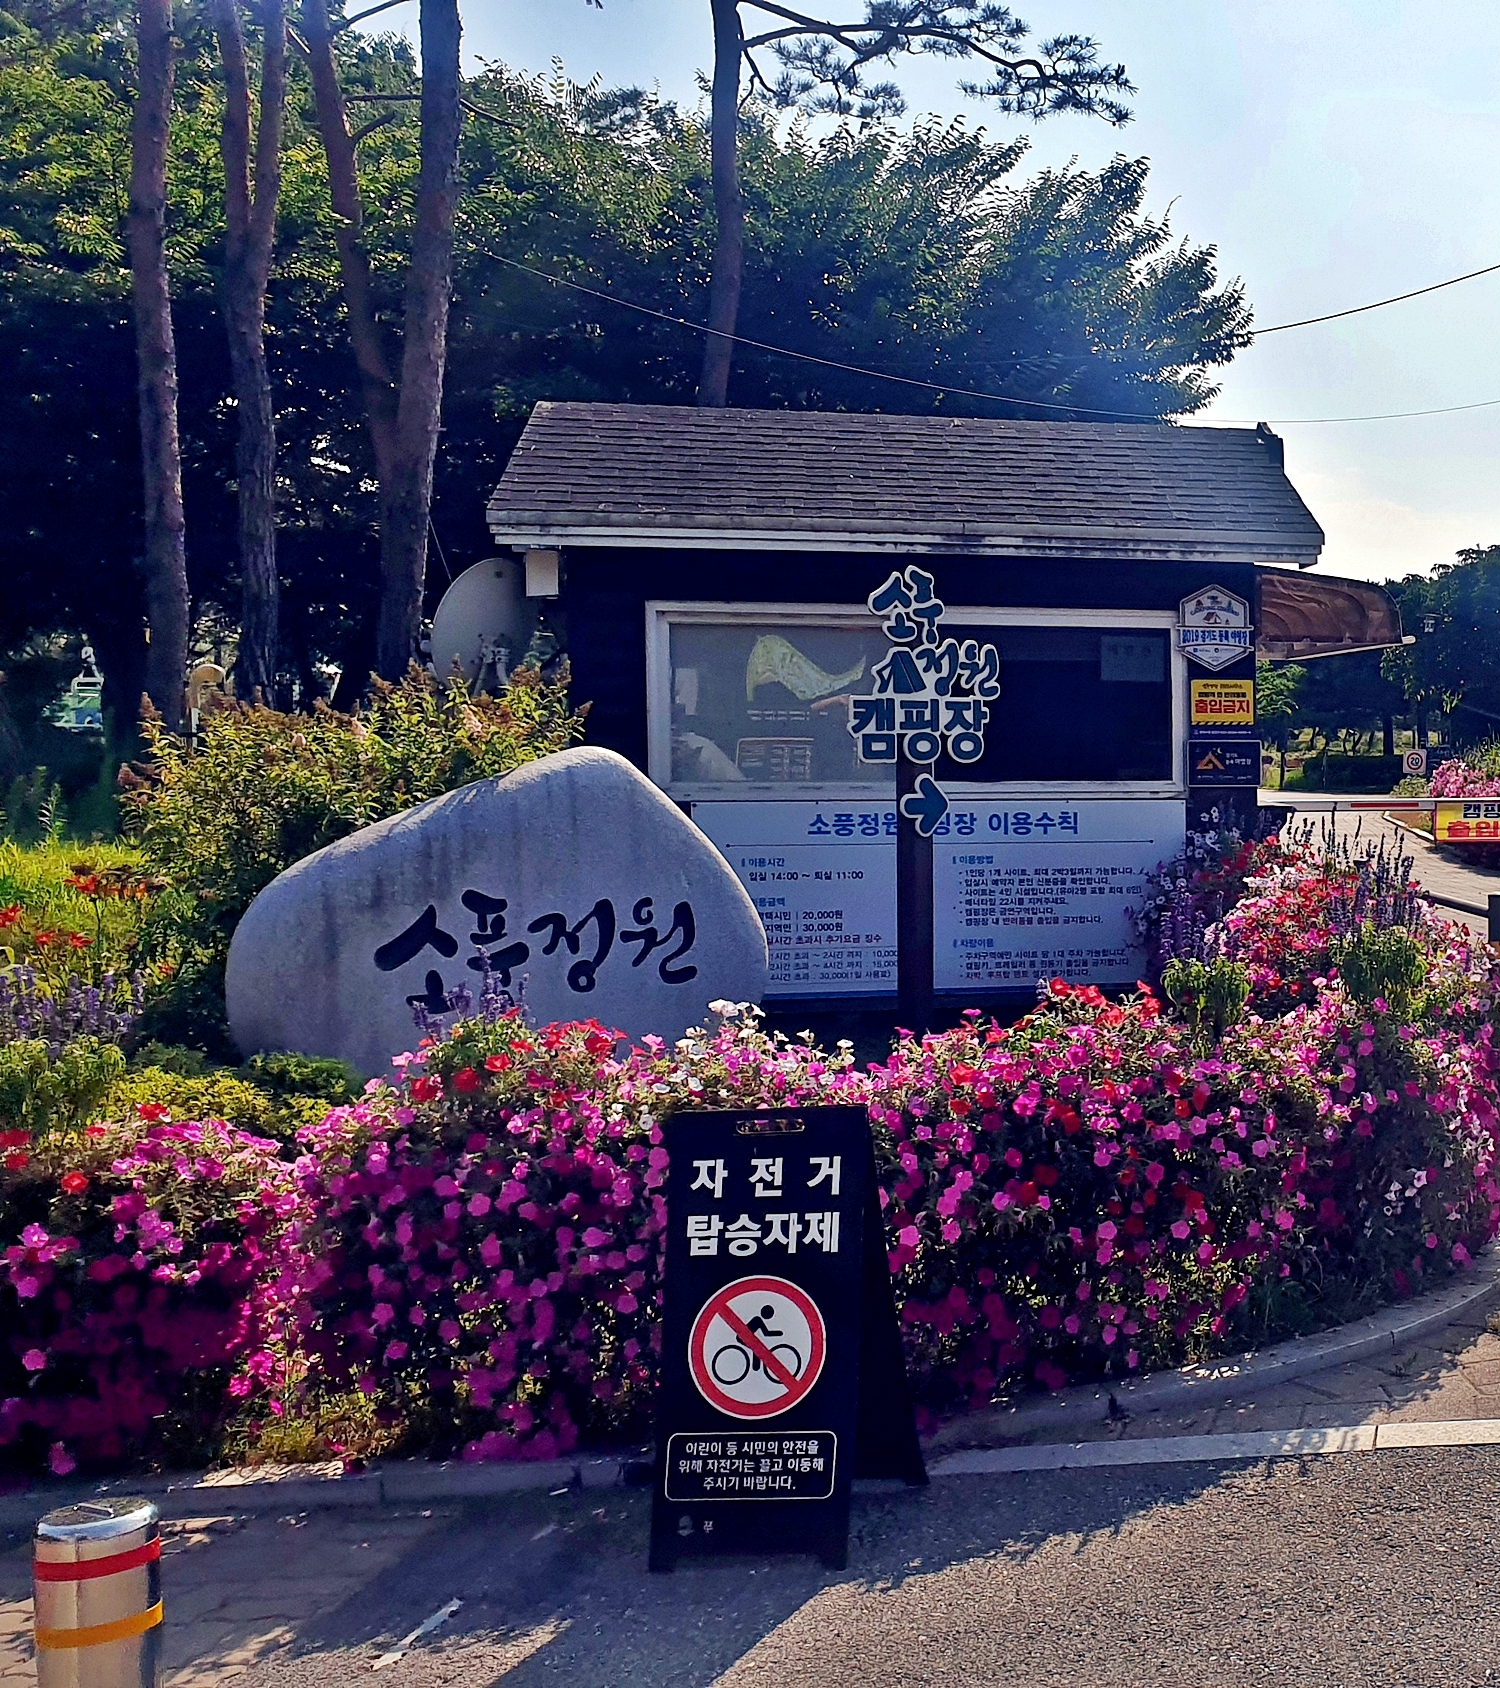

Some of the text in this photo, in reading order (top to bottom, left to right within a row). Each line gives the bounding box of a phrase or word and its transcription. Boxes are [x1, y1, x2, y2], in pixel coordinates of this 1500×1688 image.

[1182, 629, 1199, 644] 2019
[1200, 629, 1217, 643] 경기도
[1231, 629, 1247, 646] 야영장
[1194, 699, 1250, 714] 출입금지
[851, 698, 988, 762] 캠핑장
[1410, 757, 1420, 765] 20
[808, 811, 1078, 837] 소풍정원 핑장 이용수칙
[749, 857, 785, 868] 이용시간
[959, 855, 994, 865] 이용방법
[749, 871, 767, 882] 입실
[770, 871, 799, 881] 14:00
[814, 870, 832, 881] 퇴실
[836, 870, 864, 880] 11:00
[965, 869, 985, 878] 1인당
[964, 878, 989, 888] 입실시
[965, 888, 996, 897] 사이트는
[802, 910, 843, 921] 20,000원
[764, 922, 843, 933] 지역민 30,000원
[825, 934, 861, 944] 추가요금
[865, 934, 882, 943] 징수
[373, 888, 698, 1015] 소풍정원
[686, 1211, 840, 1257] 탑승자제
[685, 1440, 819, 1456] 어린이 등 시민의 안전을
[678, 1457, 824, 1473] 위해 자전거는 끌고 이동해
[703, 1475, 796, 1490] 주시기 바랍니다.
